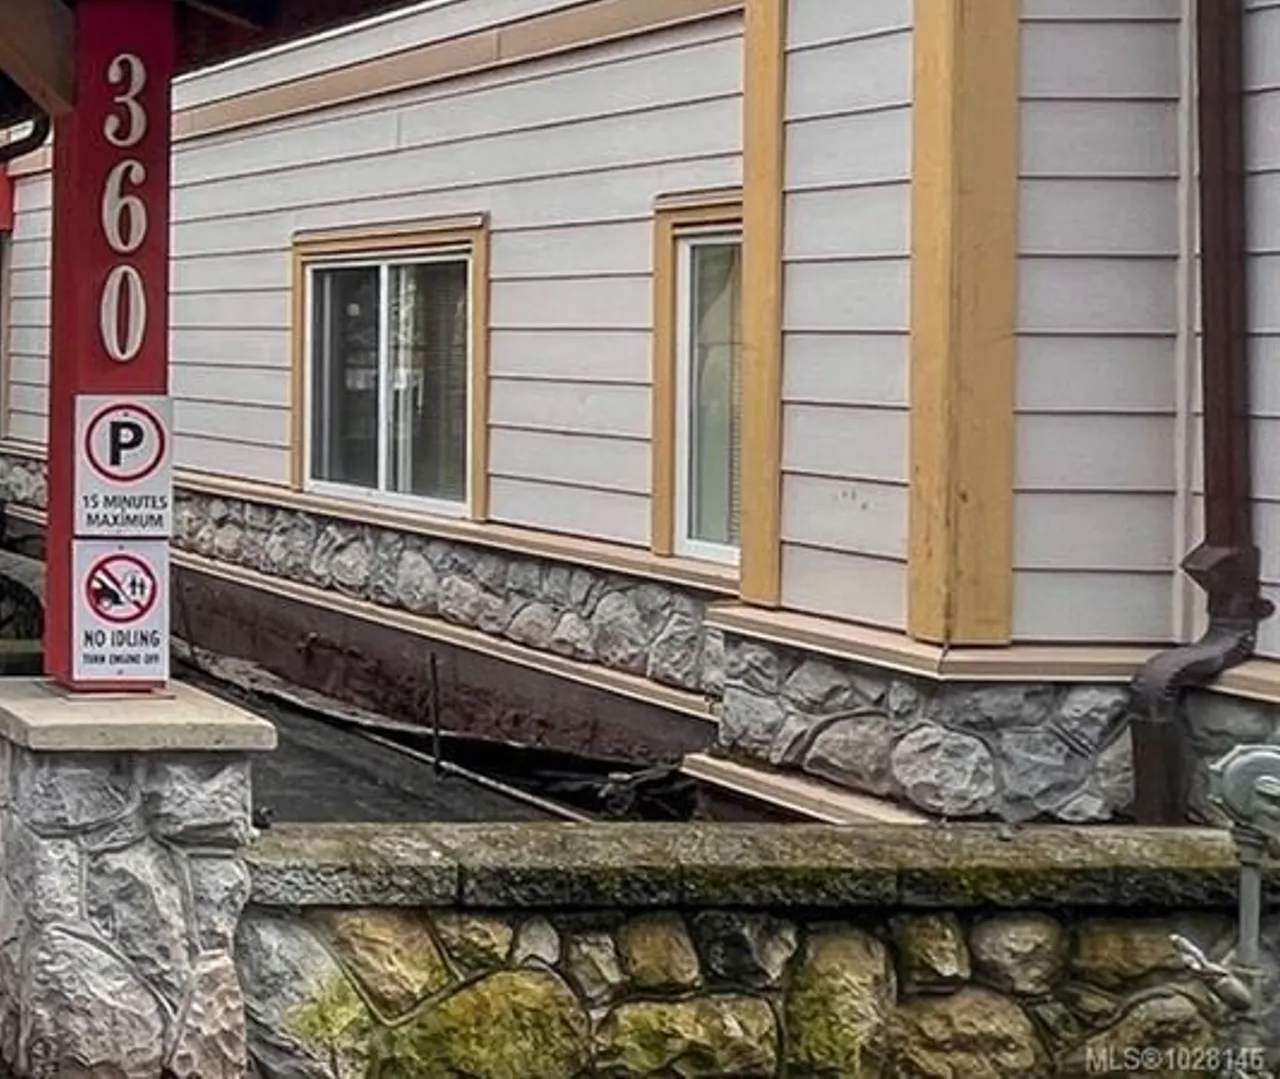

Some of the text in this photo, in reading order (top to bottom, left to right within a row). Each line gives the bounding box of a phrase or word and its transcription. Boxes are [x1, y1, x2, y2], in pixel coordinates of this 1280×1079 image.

[101, 53, 148, 362] 360
[109, 420, 144, 466] P
[82, 494, 168, 510] 15 MINUTES
[86, 512, 163, 528] MAXIMUM
[83, 629, 161, 648] NO IDLING
